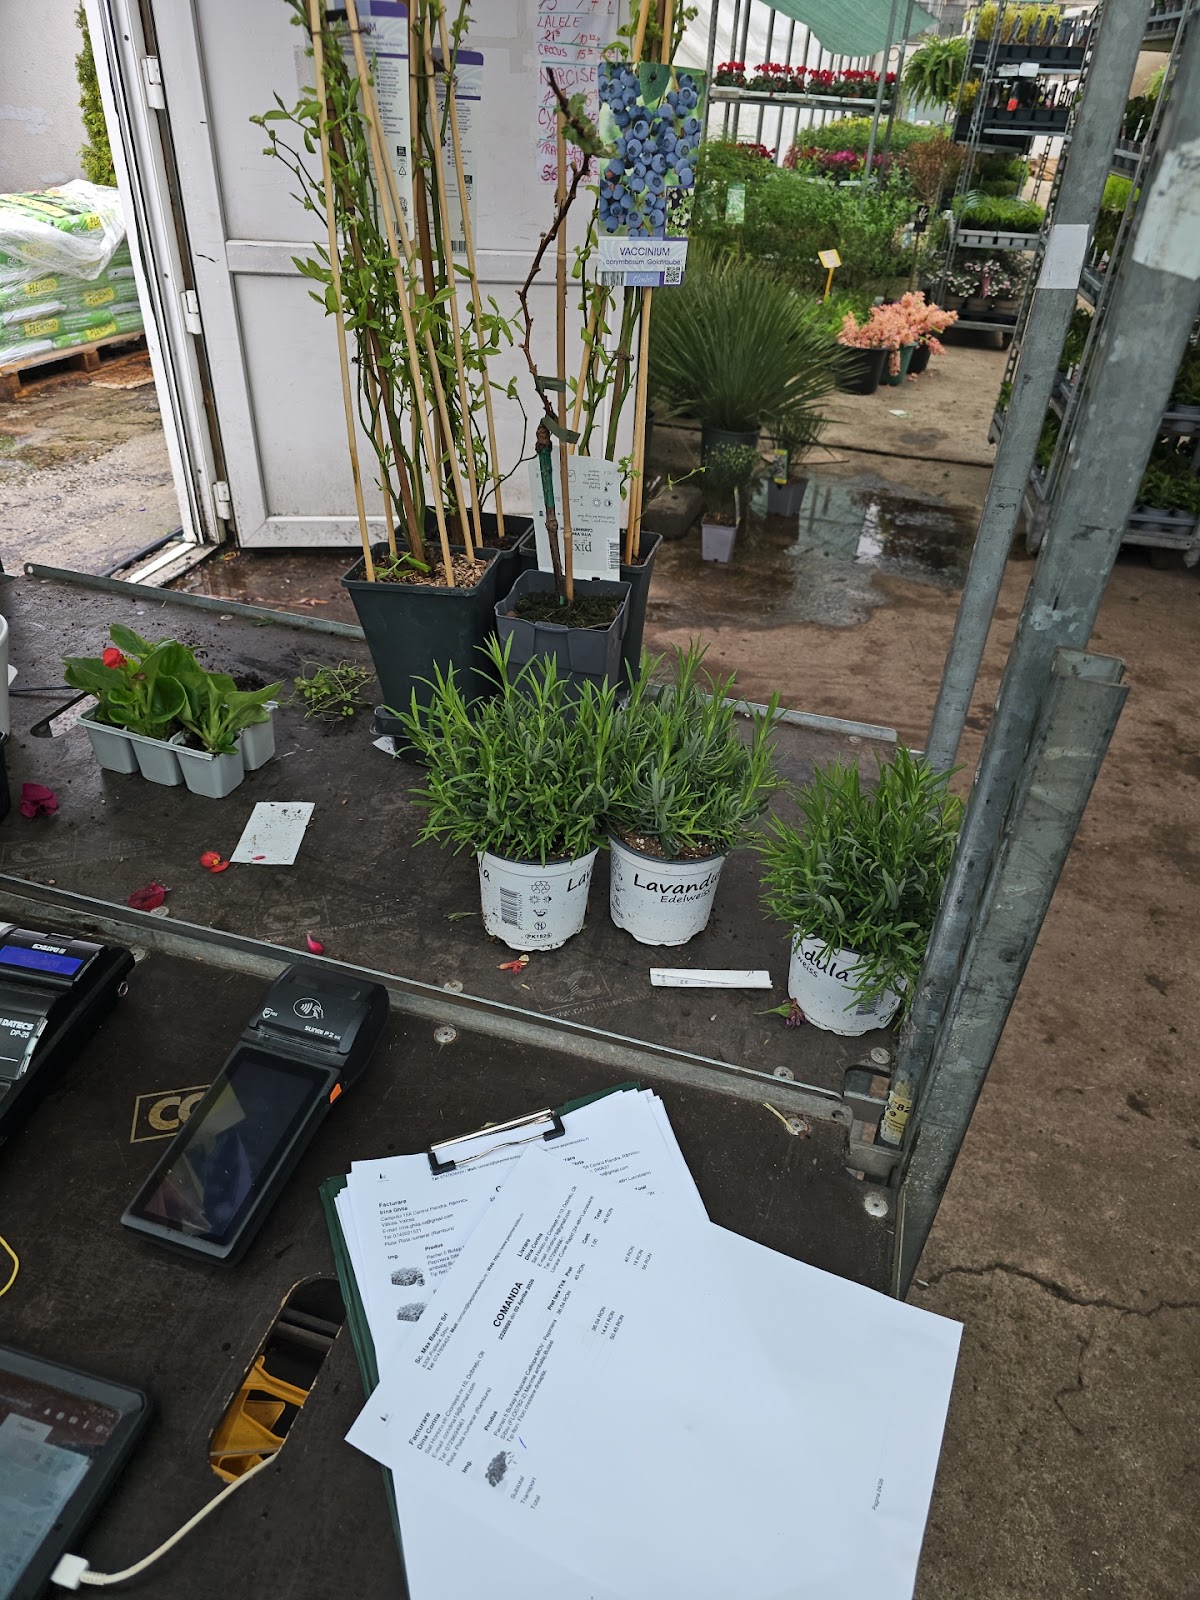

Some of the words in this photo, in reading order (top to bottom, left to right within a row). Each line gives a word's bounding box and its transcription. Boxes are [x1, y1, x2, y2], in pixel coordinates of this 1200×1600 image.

[538, 44, 568, 57] CROCUS
[619, 247, 670, 256] VACCINIUM
[2, 1018, 34, 1031] DATECS
[10, 1029, 30, 1039] DP-25
[378, 1199, 407, 1208] Facturare
[593, 1208, 603, 1220] Total
[424, 1243, 444, 1251] Produs
[516, 1238, 531, 1257] Livrare
[524, 1249, 534, 1261] Dina
[530, 1232, 543, 1249] Corina
[635, 1248, 644, 1261] RON
[643, 1252, 653, 1265] RON
[576, 1263, 586, 1275] RON
[547, 1299, 556, 1311] Pret
[557, 1279, 566, 1290] TVA
[562, 1290, 572, 1302] RON
[493, 1282, 523, 1327] COMANDA
[597, 1306, 606, 1319] RON
[606, 1310, 616, 1323] RON
[615, 1314, 625, 1327] RON
[414, 1355, 424, 1364] Sc.
[420, 1342, 431, 1354] Max
[428, 1321, 443, 1342] Bayern
[440, 1312, 449, 1322] Srl
[483, 1410, 498, 1432] Produs
[493, 1417, 507, 1437] Pachet
[408, 1412, 431, 1446] Facturare
[416, 1434, 429, 1450] Dina
[425, 1413, 441, 1434] Corina
[510, 1475, 525, 1500] Subtotal
[519, 1477, 537, 1504] Transport
[529, 1494, 541, 1510] Total
